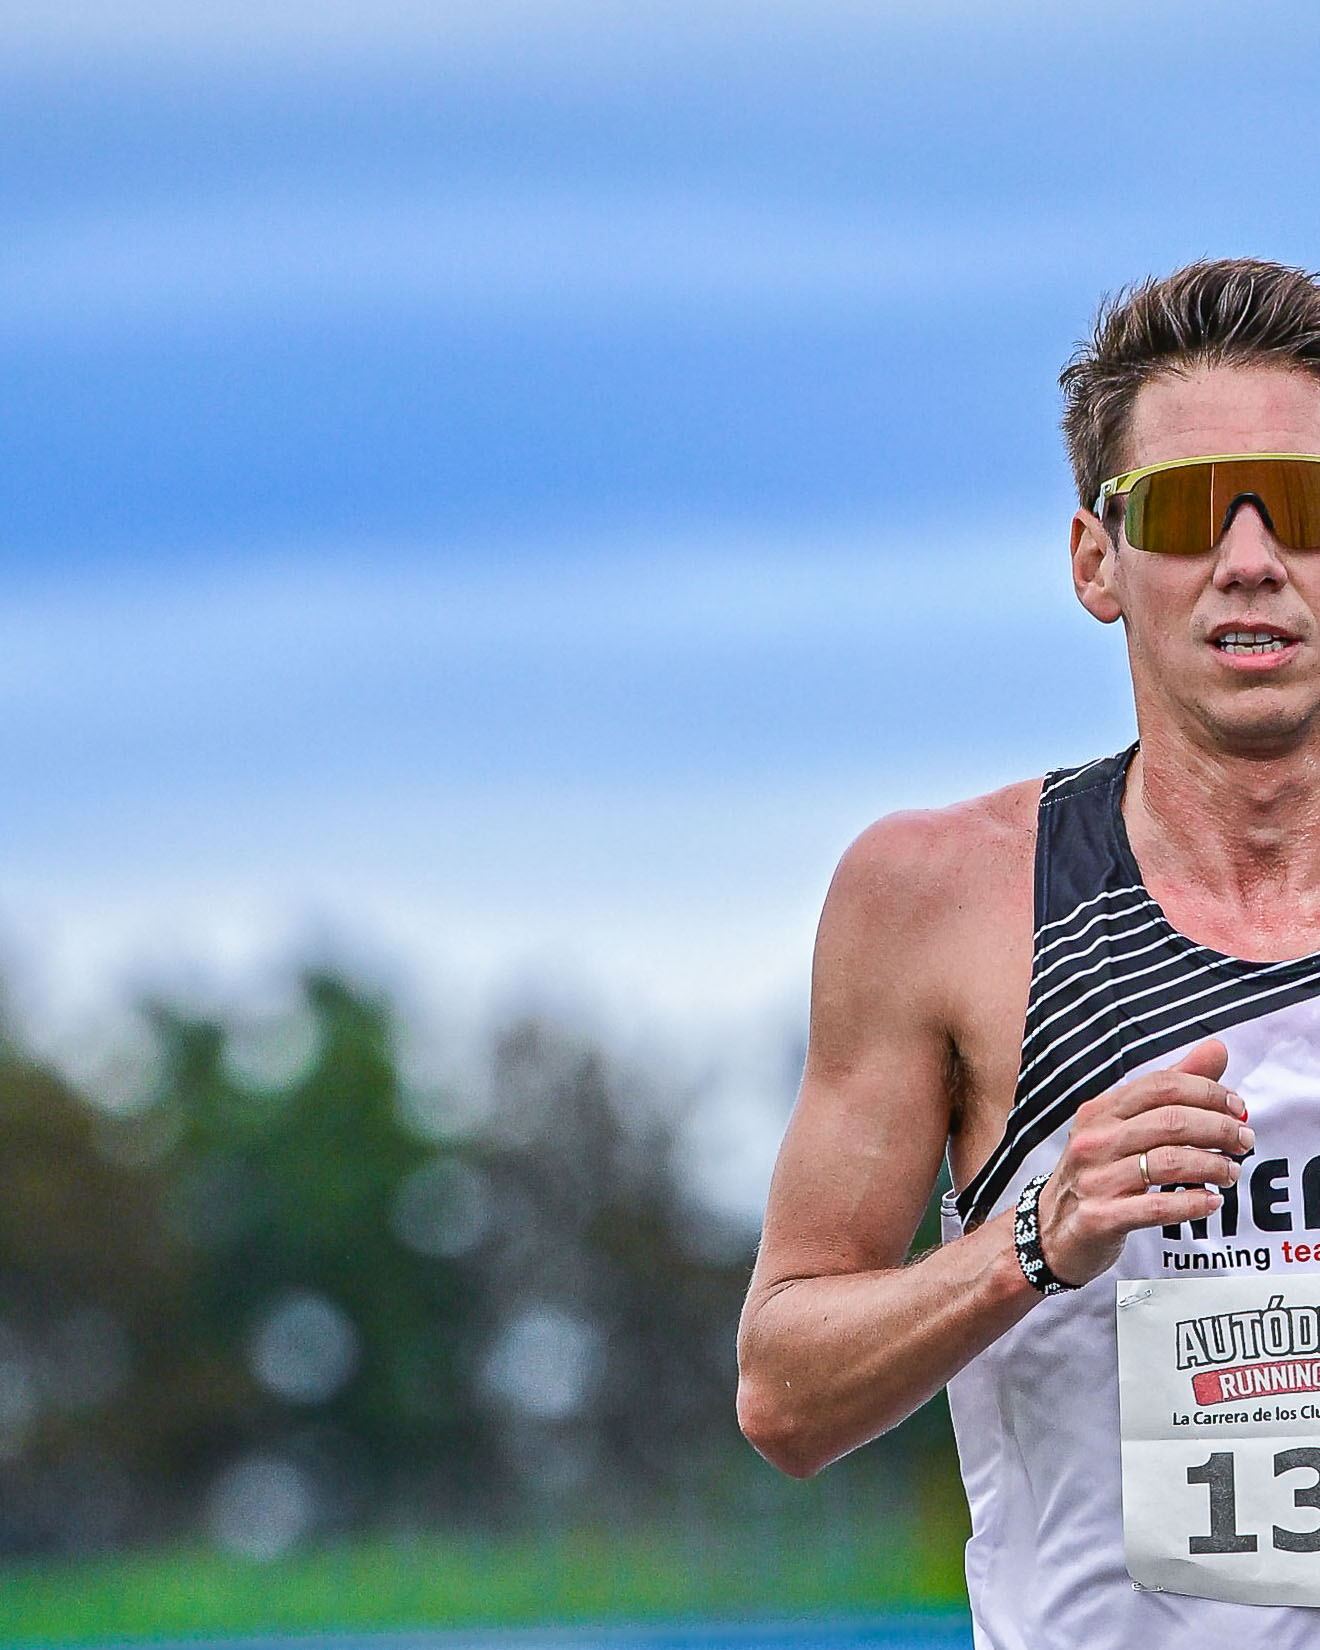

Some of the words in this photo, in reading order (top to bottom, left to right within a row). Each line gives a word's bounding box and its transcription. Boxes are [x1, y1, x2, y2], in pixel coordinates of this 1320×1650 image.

[1163, 1245, 1271, 1271] running
[1173, 1412, 1189, 1426] La
[1193, 1410, 1249, 1425] Carrera
[1253, 1407, 1271, 1422] de
[1276, 1406, 1297, 1420] los
